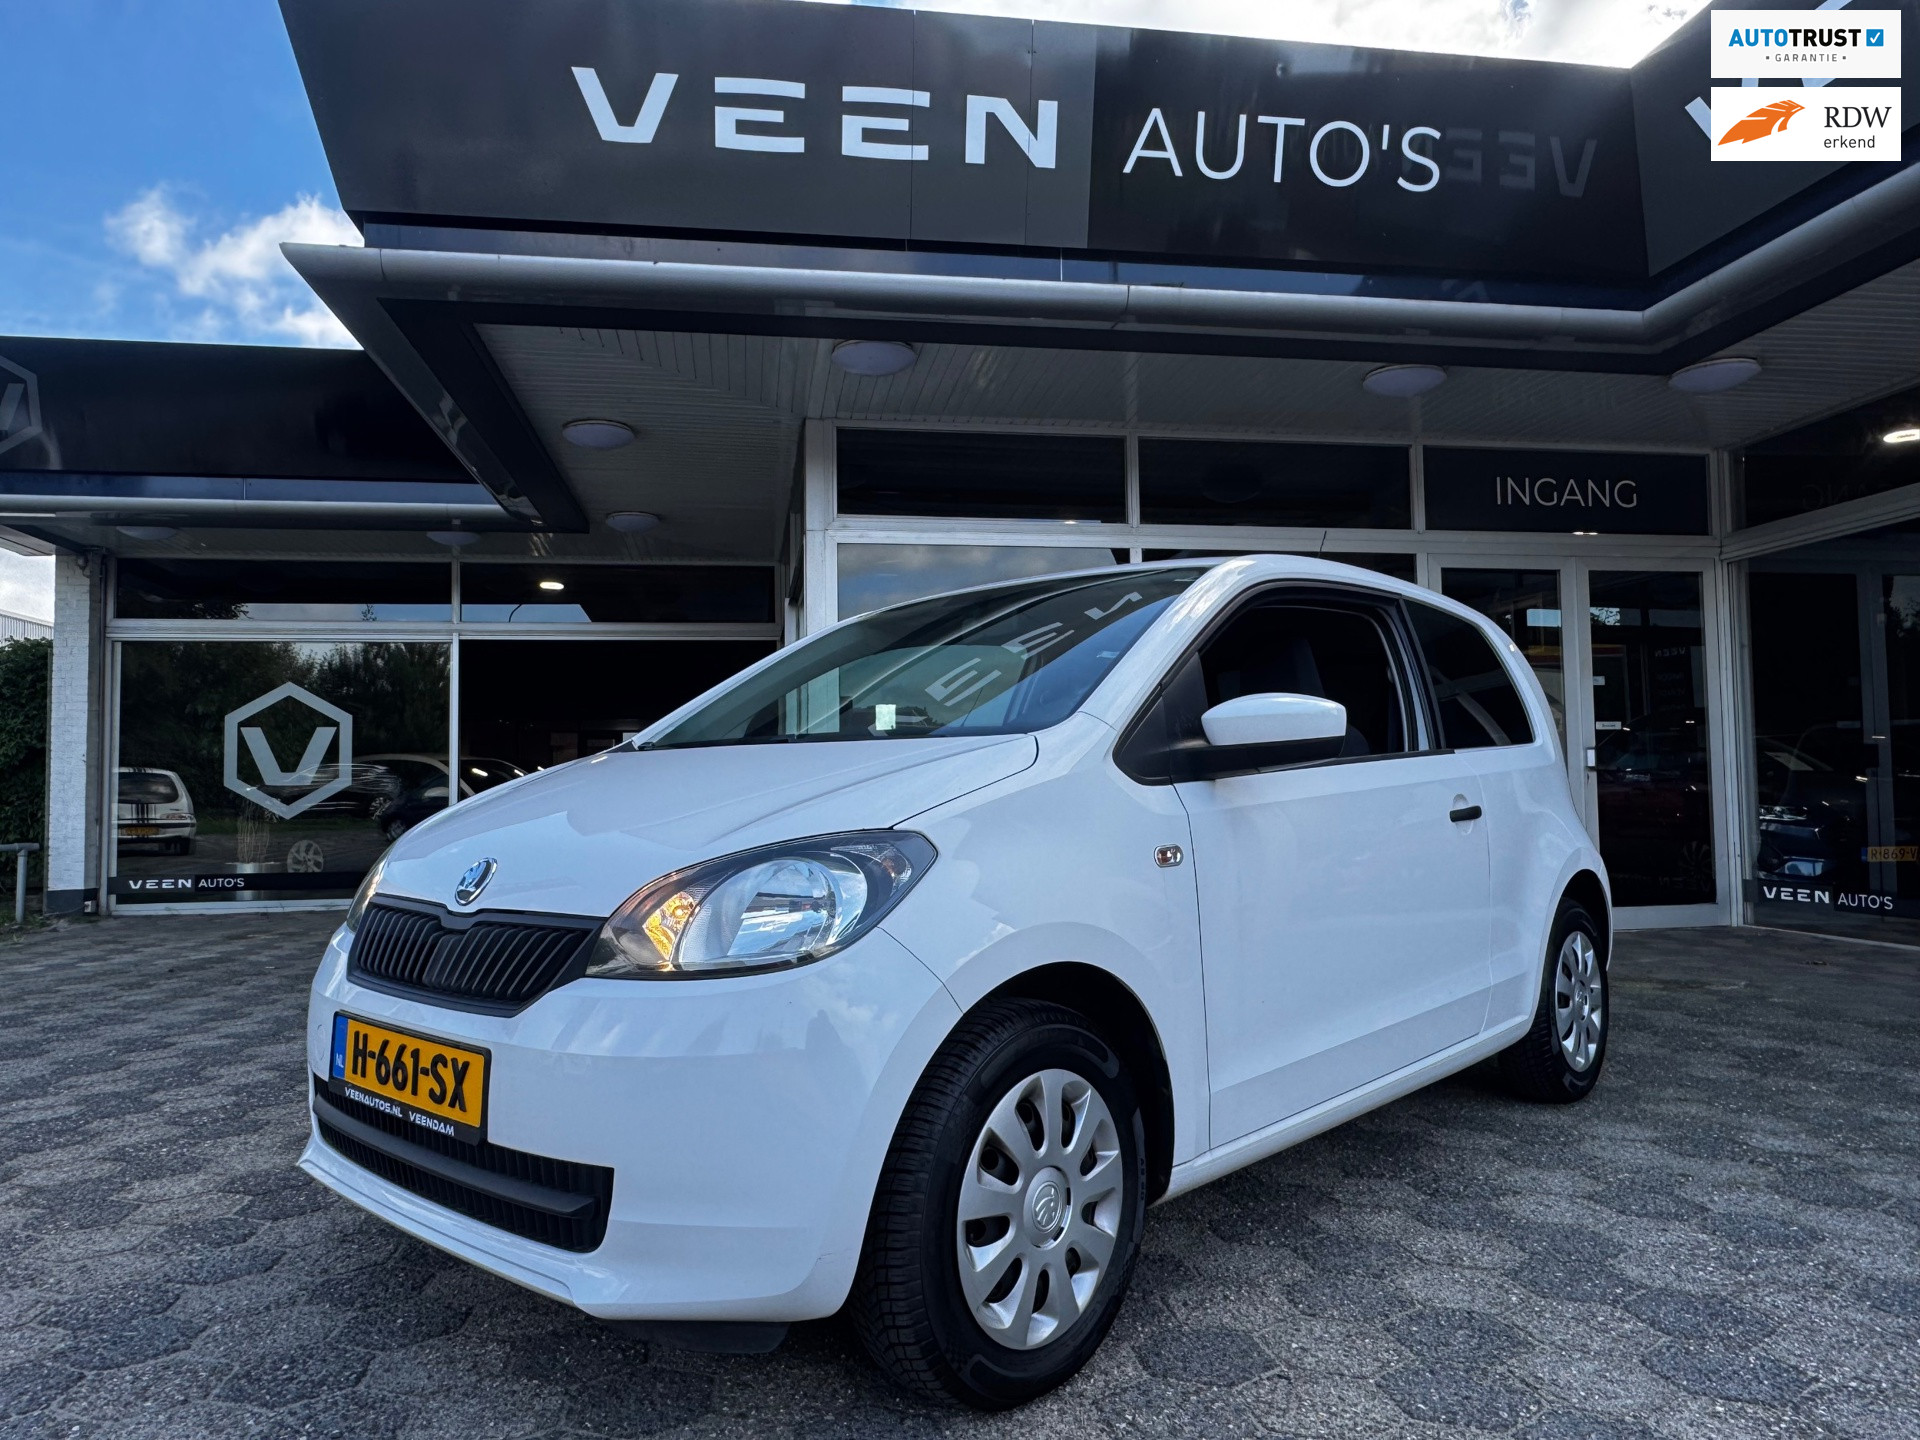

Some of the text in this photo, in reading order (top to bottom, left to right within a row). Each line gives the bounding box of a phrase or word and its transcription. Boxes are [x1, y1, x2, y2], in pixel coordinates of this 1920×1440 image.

[570, 66, 1442, 193] VEEN AUTO'S
[1495, 476, 1638, 508] INGANG
[239, 726, 338, 786] V
[128, 877, 245, 890] VEEN AUTO'S
[1762, 885, 1894, 910] VEEN AUTO'S
[335, 1052, 345, 1069] NL
[351, 1030, 471, 1113] H-661-SX
[344, 1086, 455, 1137] VEENAUTOS.NL VEENDAM
